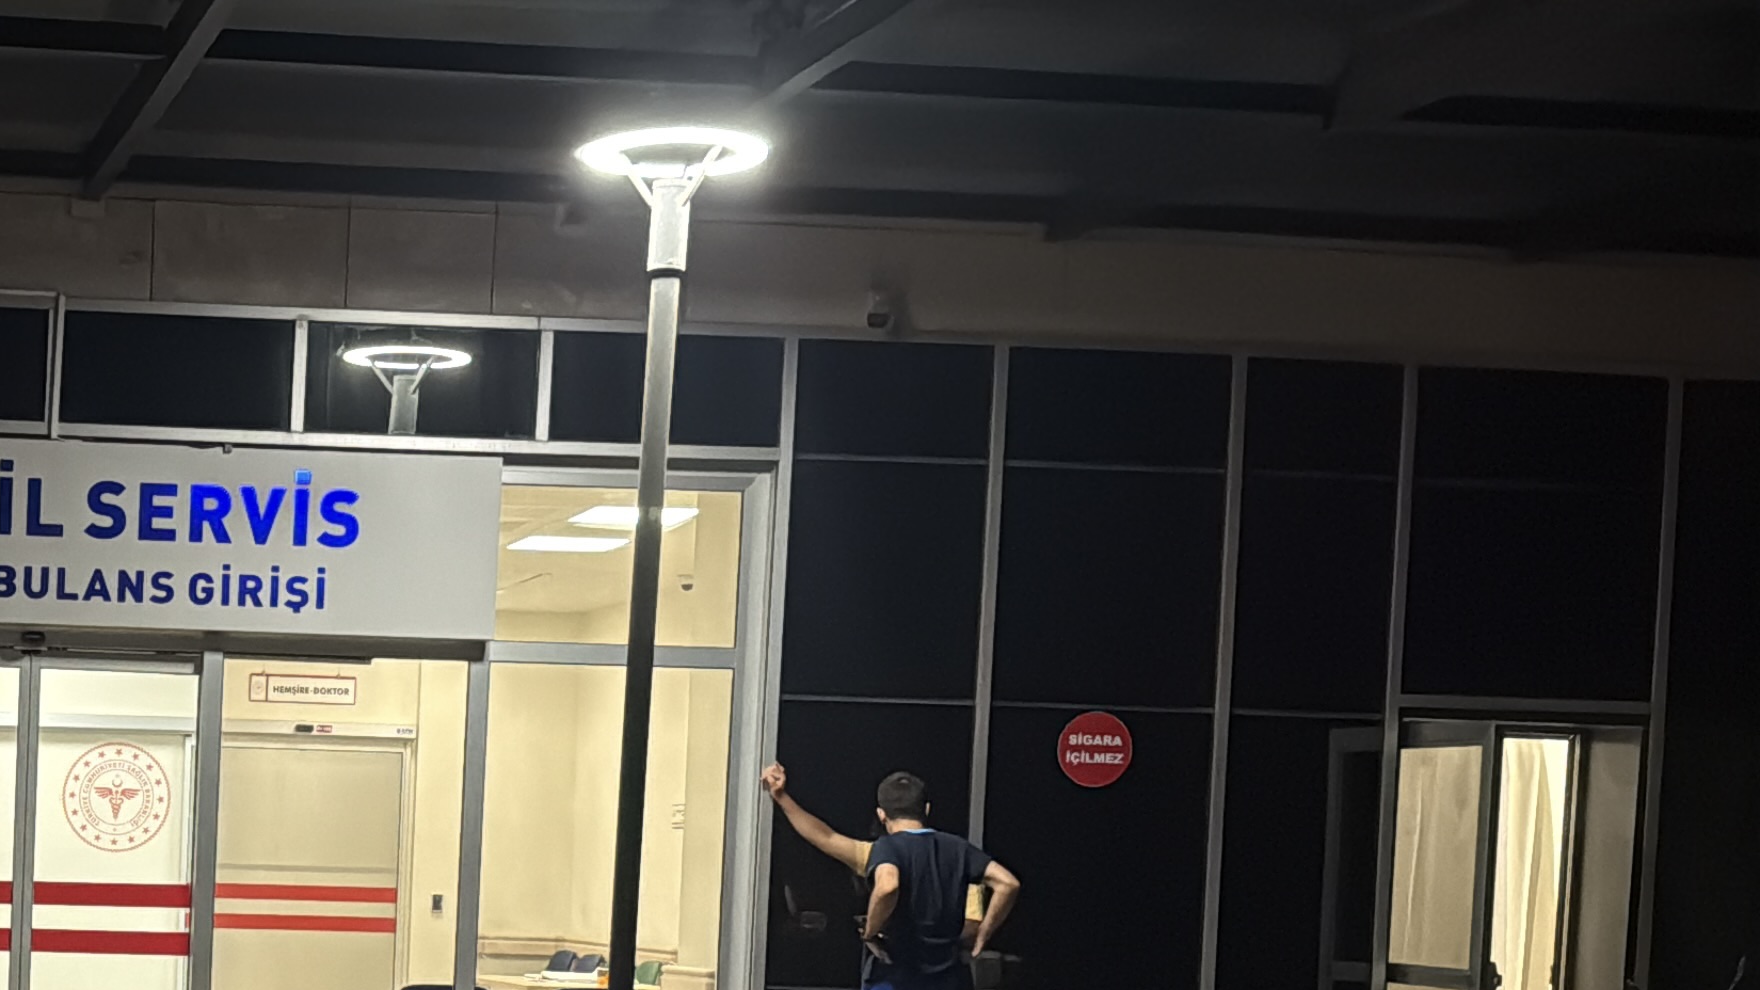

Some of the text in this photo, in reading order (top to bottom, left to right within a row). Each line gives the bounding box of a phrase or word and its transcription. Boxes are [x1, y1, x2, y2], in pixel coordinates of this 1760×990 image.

[84, 469, 360, 548] SERVİS
[189, 563, 326, 613] GİRİŞİ
[1068, 732, 1123, 746] SİGARA
[1066, 750, 1124, 766] İÇİLMEZ
